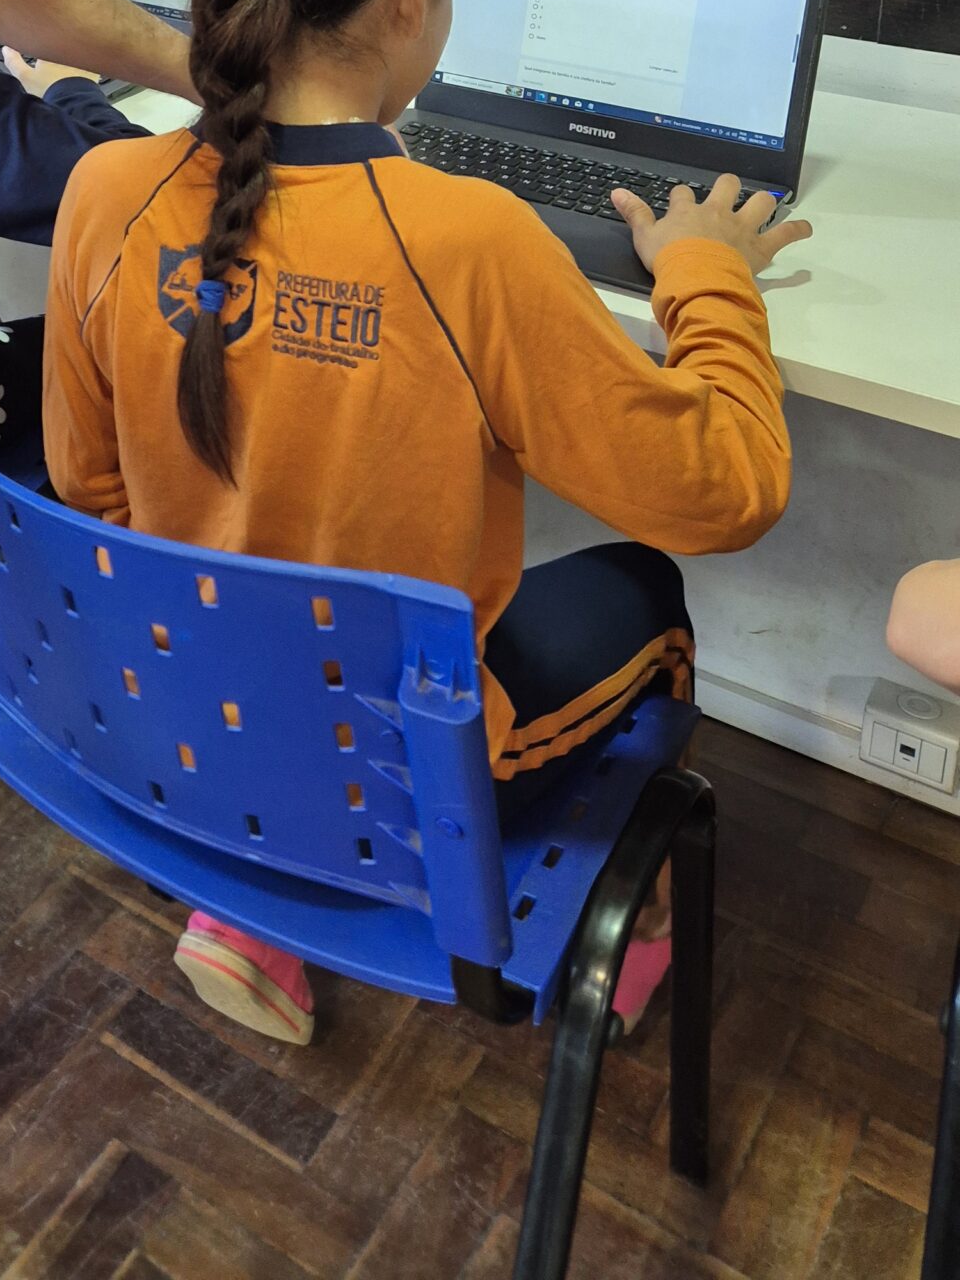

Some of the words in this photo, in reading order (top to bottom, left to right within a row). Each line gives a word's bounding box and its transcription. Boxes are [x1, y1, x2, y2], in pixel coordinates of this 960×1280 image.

[568, 122, 616, 140] POSITIVO
[276, 270, 361, 303] PREFEITURA
[364, 285, 385, 307] DE
[272, 290, 381, 348] ESTEIO
